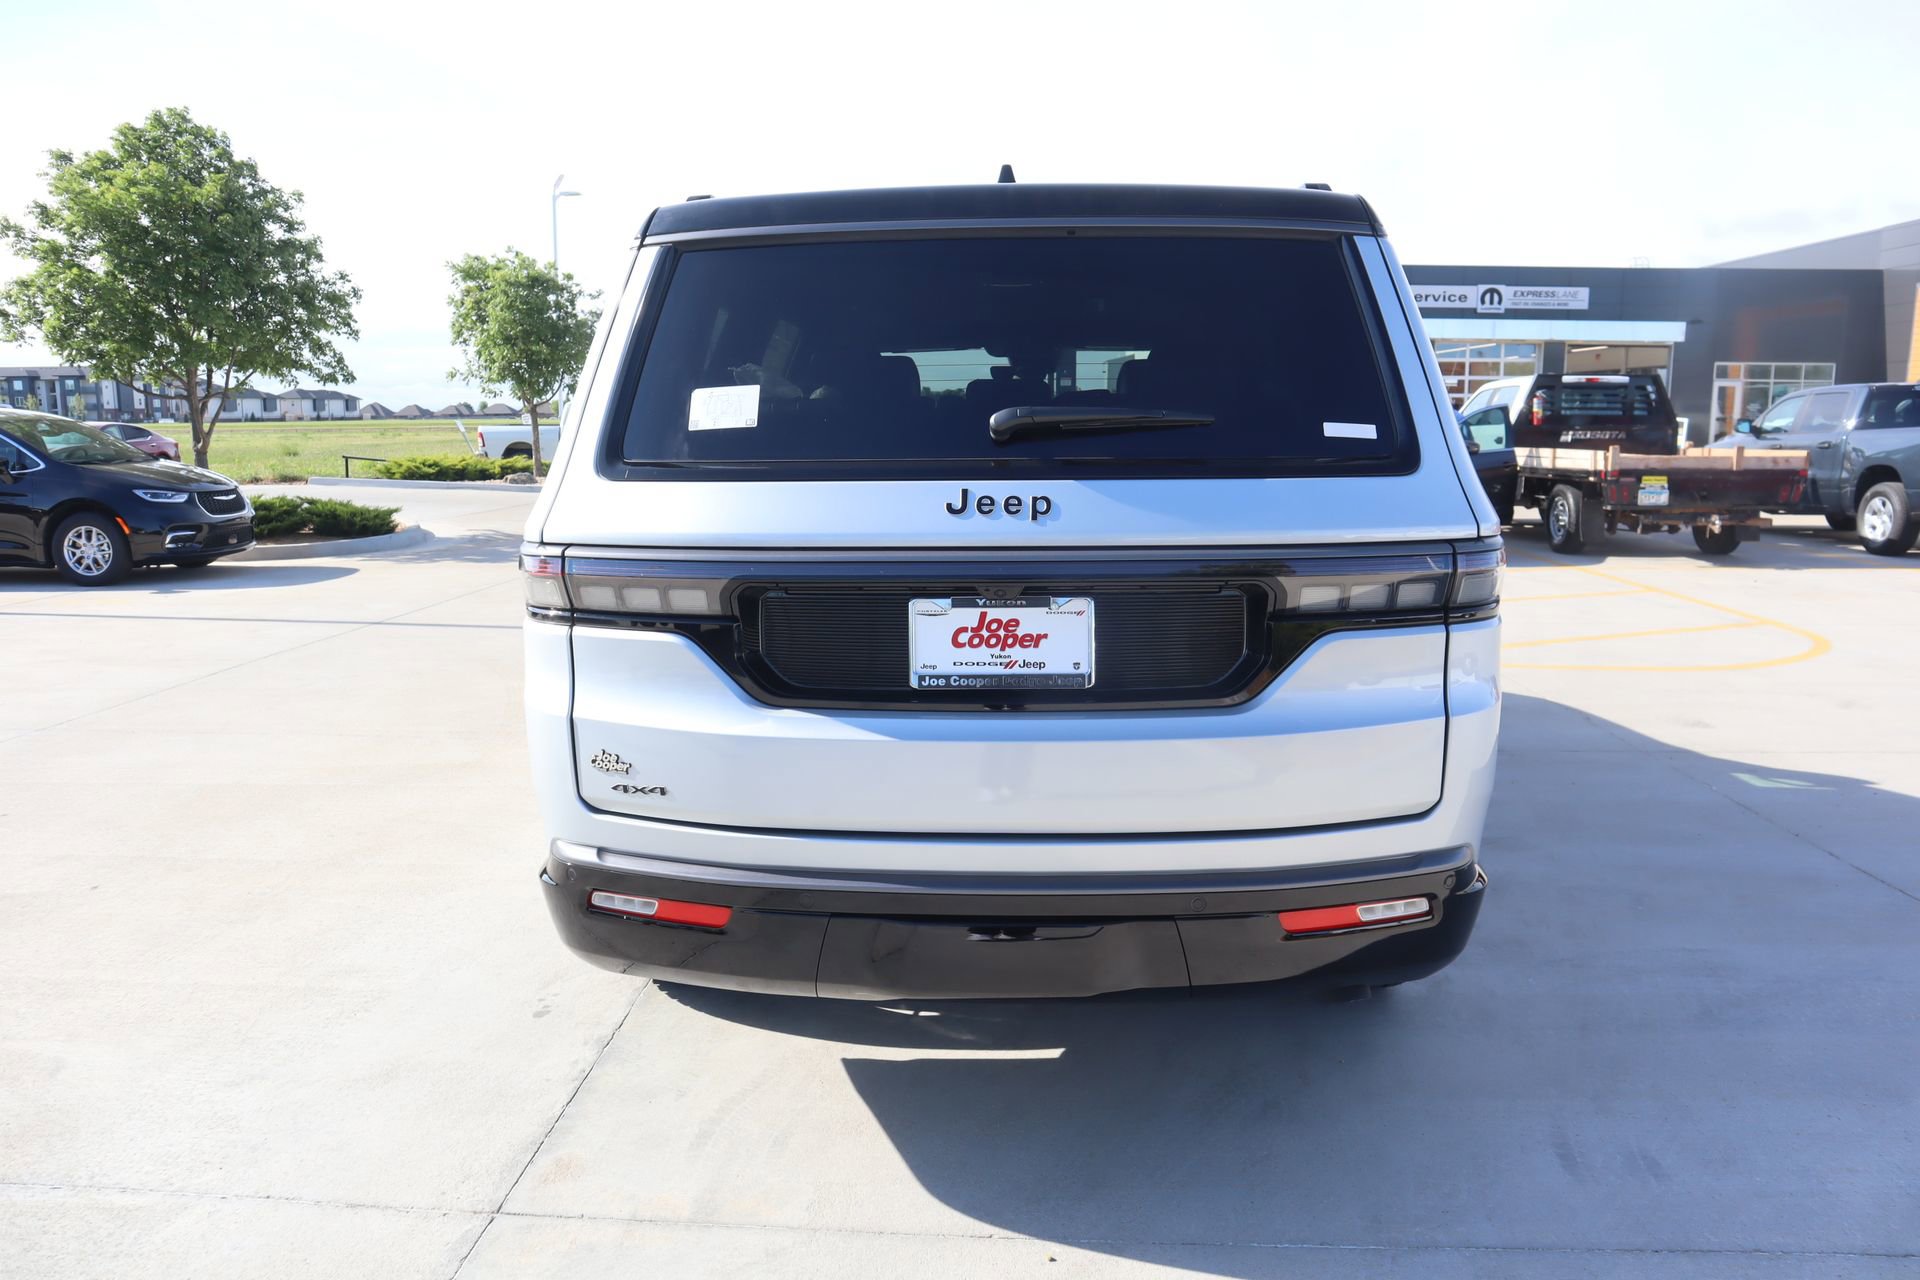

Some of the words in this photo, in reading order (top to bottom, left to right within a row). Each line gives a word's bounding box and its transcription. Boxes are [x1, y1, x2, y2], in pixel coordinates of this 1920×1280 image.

[1414, 291, 1468, 303] ervice
[945, 488, 1052, 521] Jeep
[970, 611, 1020, 634] Joe
[951, 626, 1049, 652] Cooper
[1018, 659, 1046, 670] Jeep
[921, 676, 946, 686] Joe
[950, 676, 999, 688] Cooper
